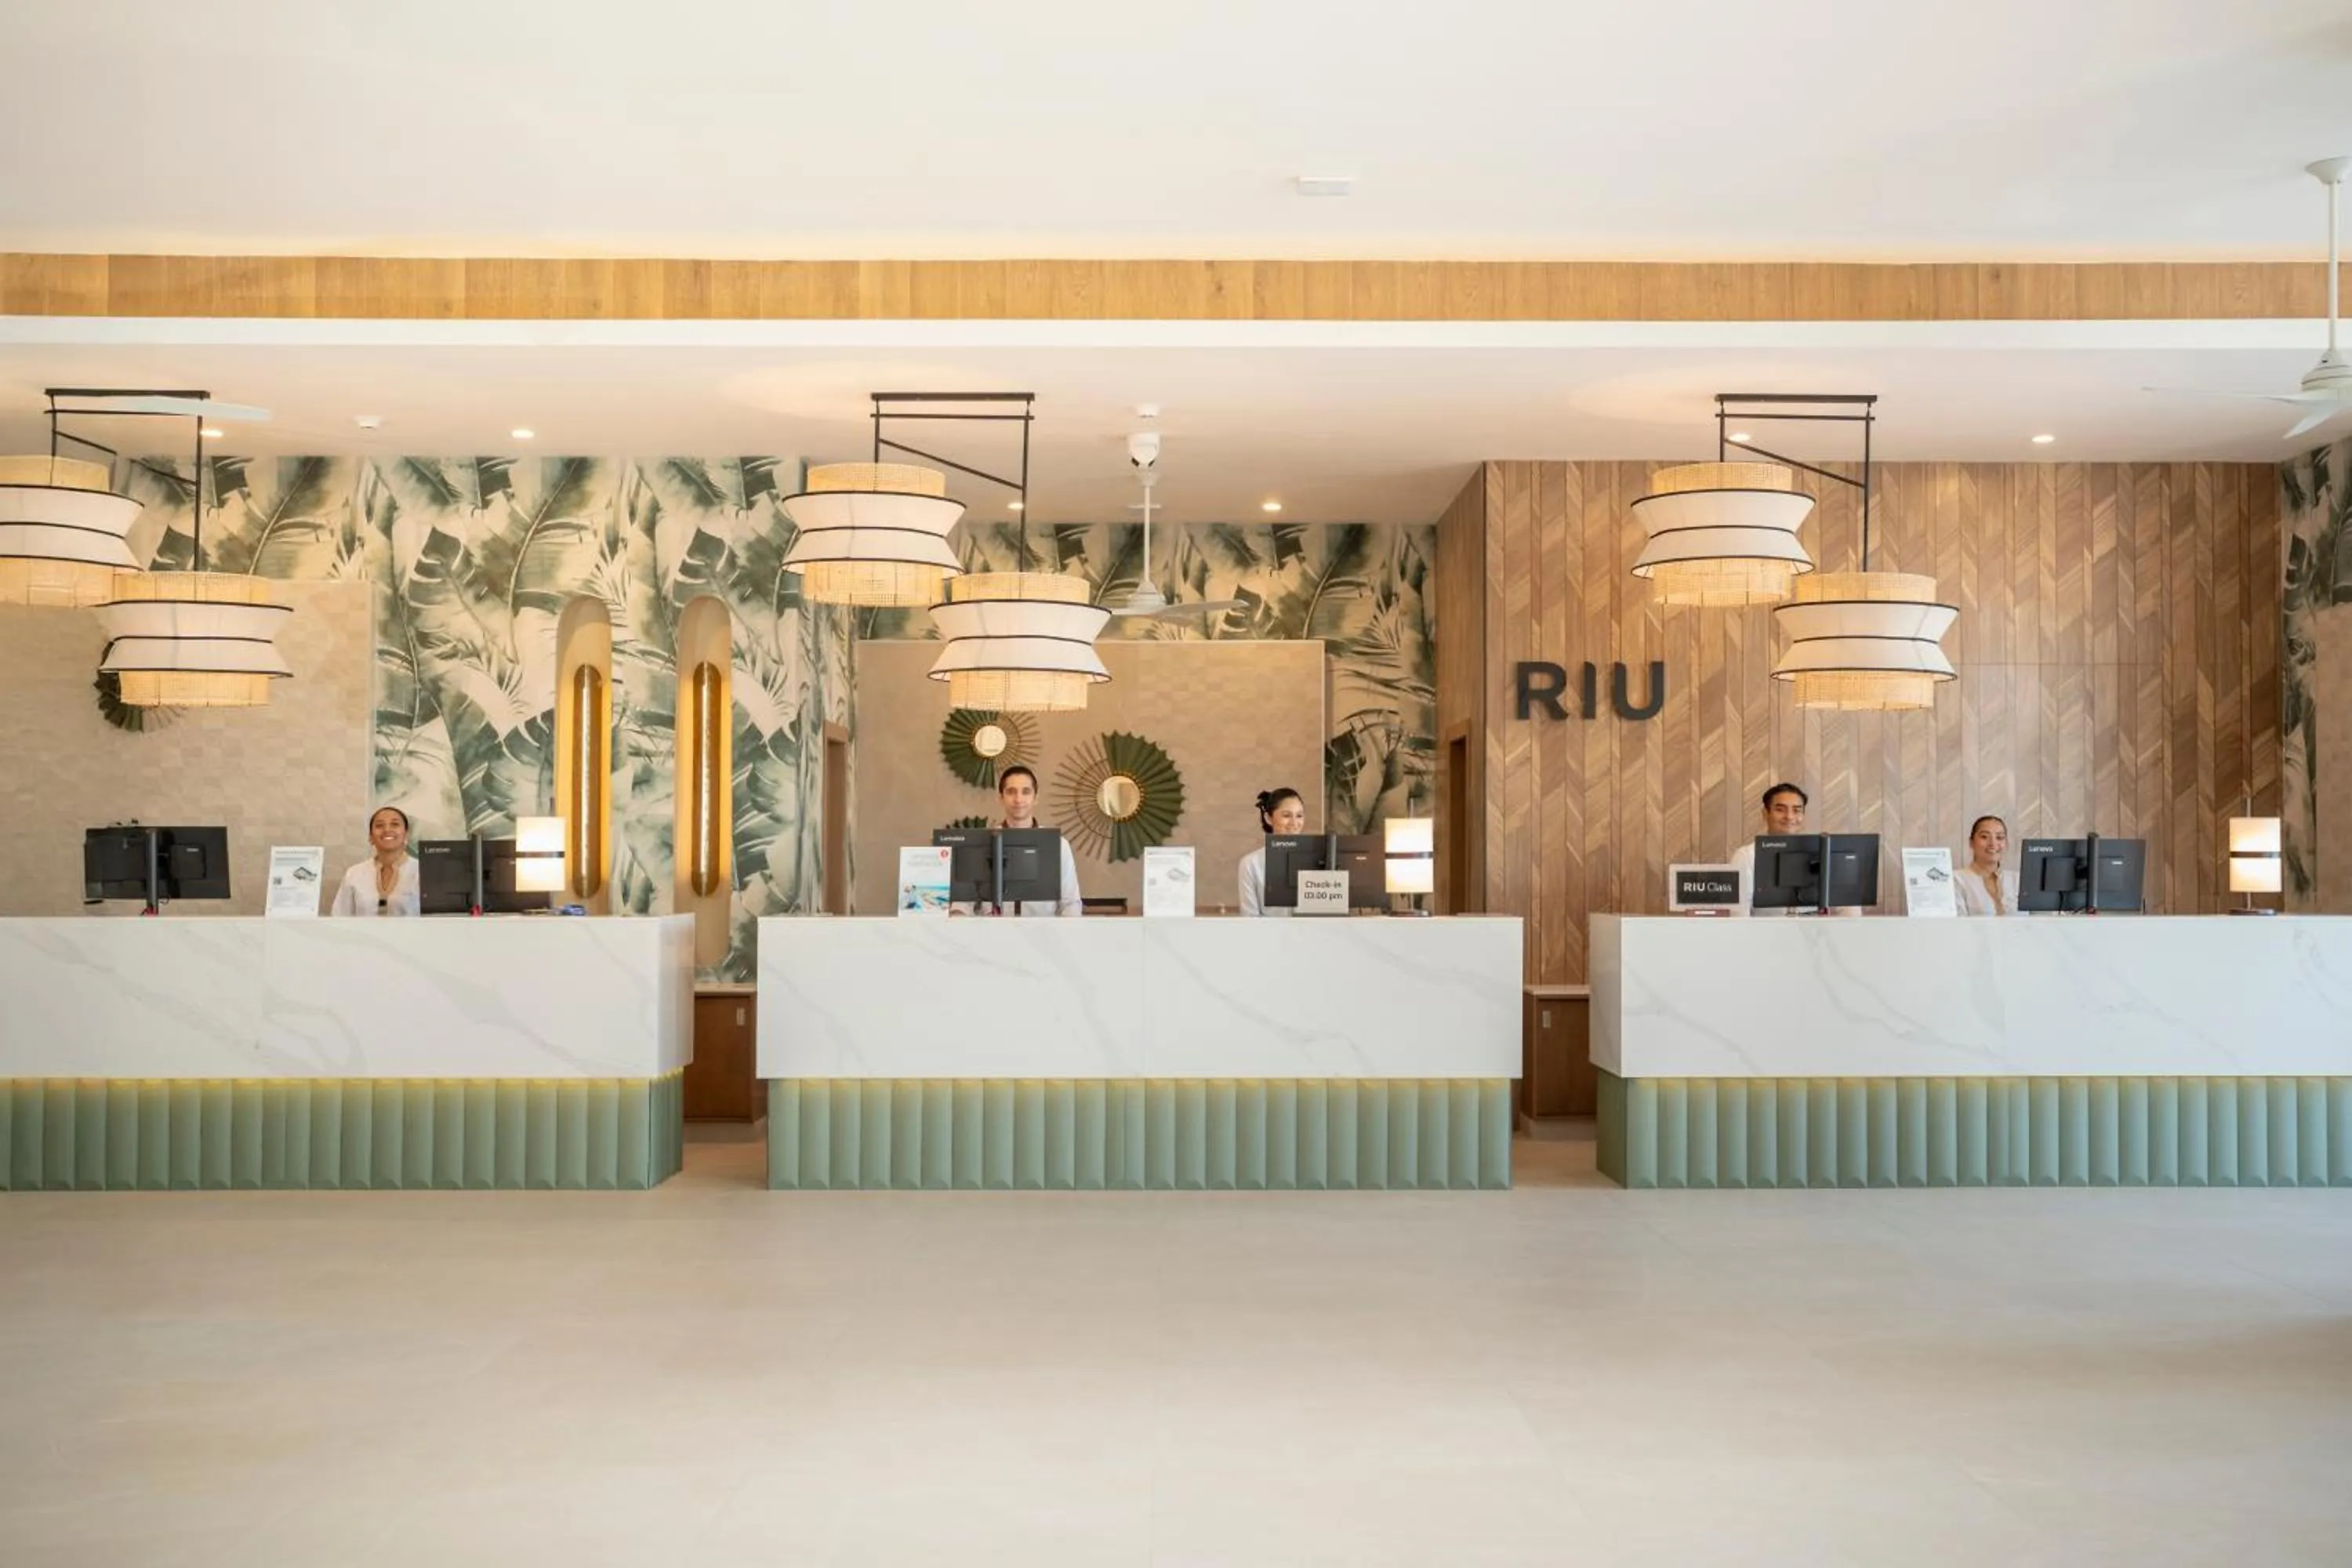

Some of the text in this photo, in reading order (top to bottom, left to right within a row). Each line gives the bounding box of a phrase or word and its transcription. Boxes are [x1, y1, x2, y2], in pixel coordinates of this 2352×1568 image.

[1517, 661, 1664, 720] RIU
[1305, 880, 1341, 888] Check-in
[1683, 882, 1732, 891] RIU Class
